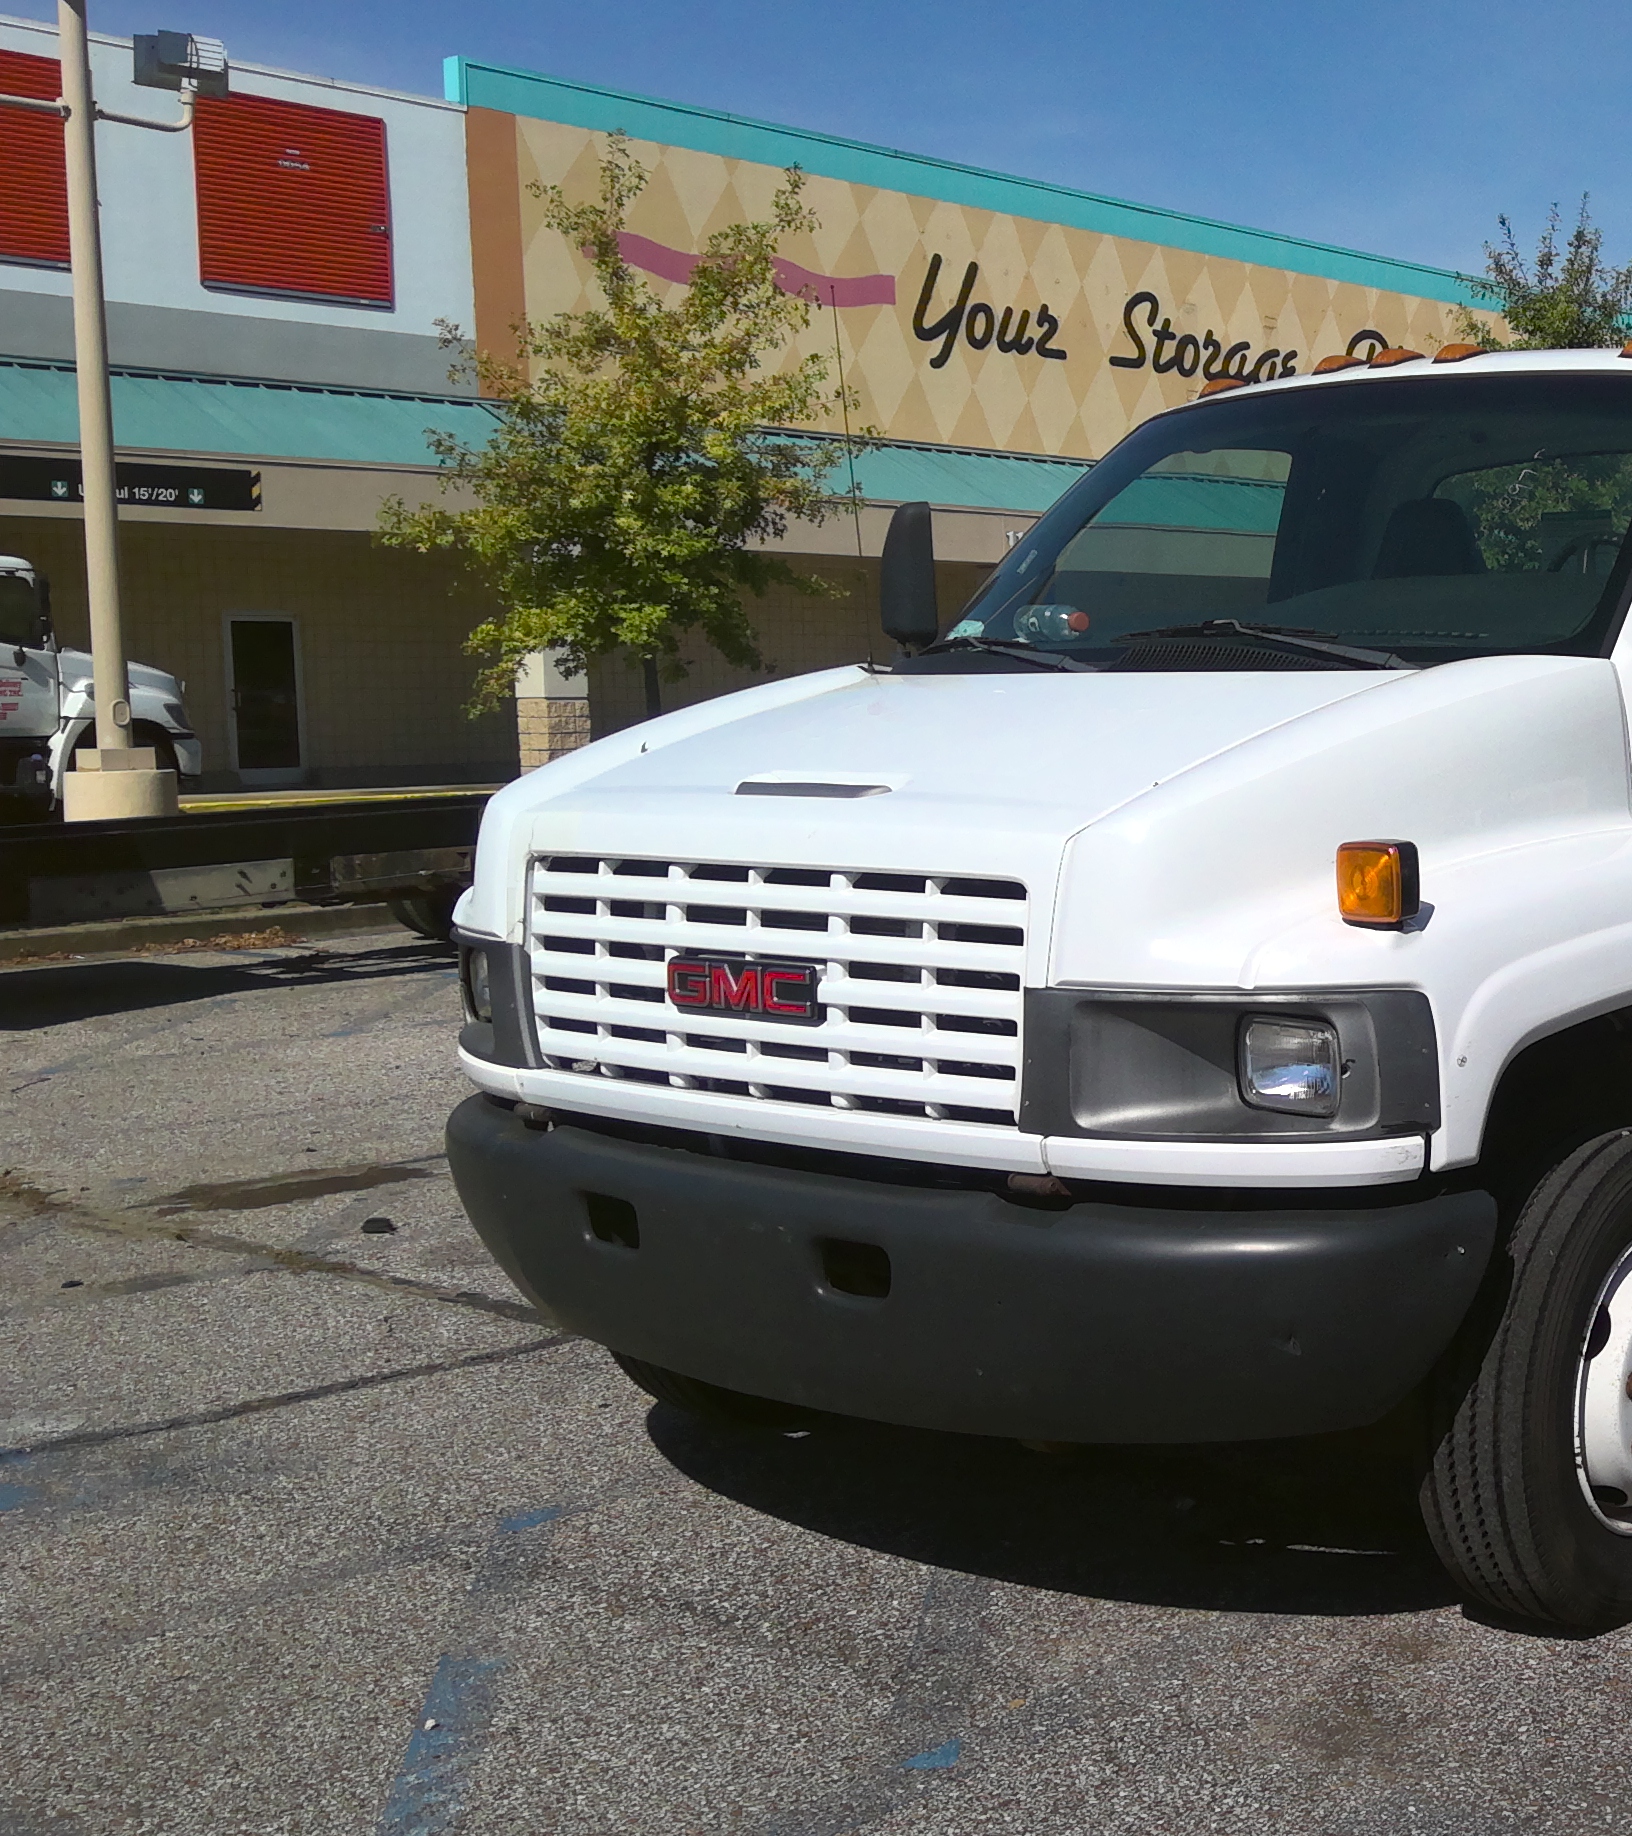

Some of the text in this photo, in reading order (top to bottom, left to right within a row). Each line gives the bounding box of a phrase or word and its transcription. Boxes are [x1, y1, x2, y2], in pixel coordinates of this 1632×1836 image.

[913, 253, 1067, 369] Your
[132, 487, 179, 501] 15'/20'
[667, 961, 812, 1018] GMC
